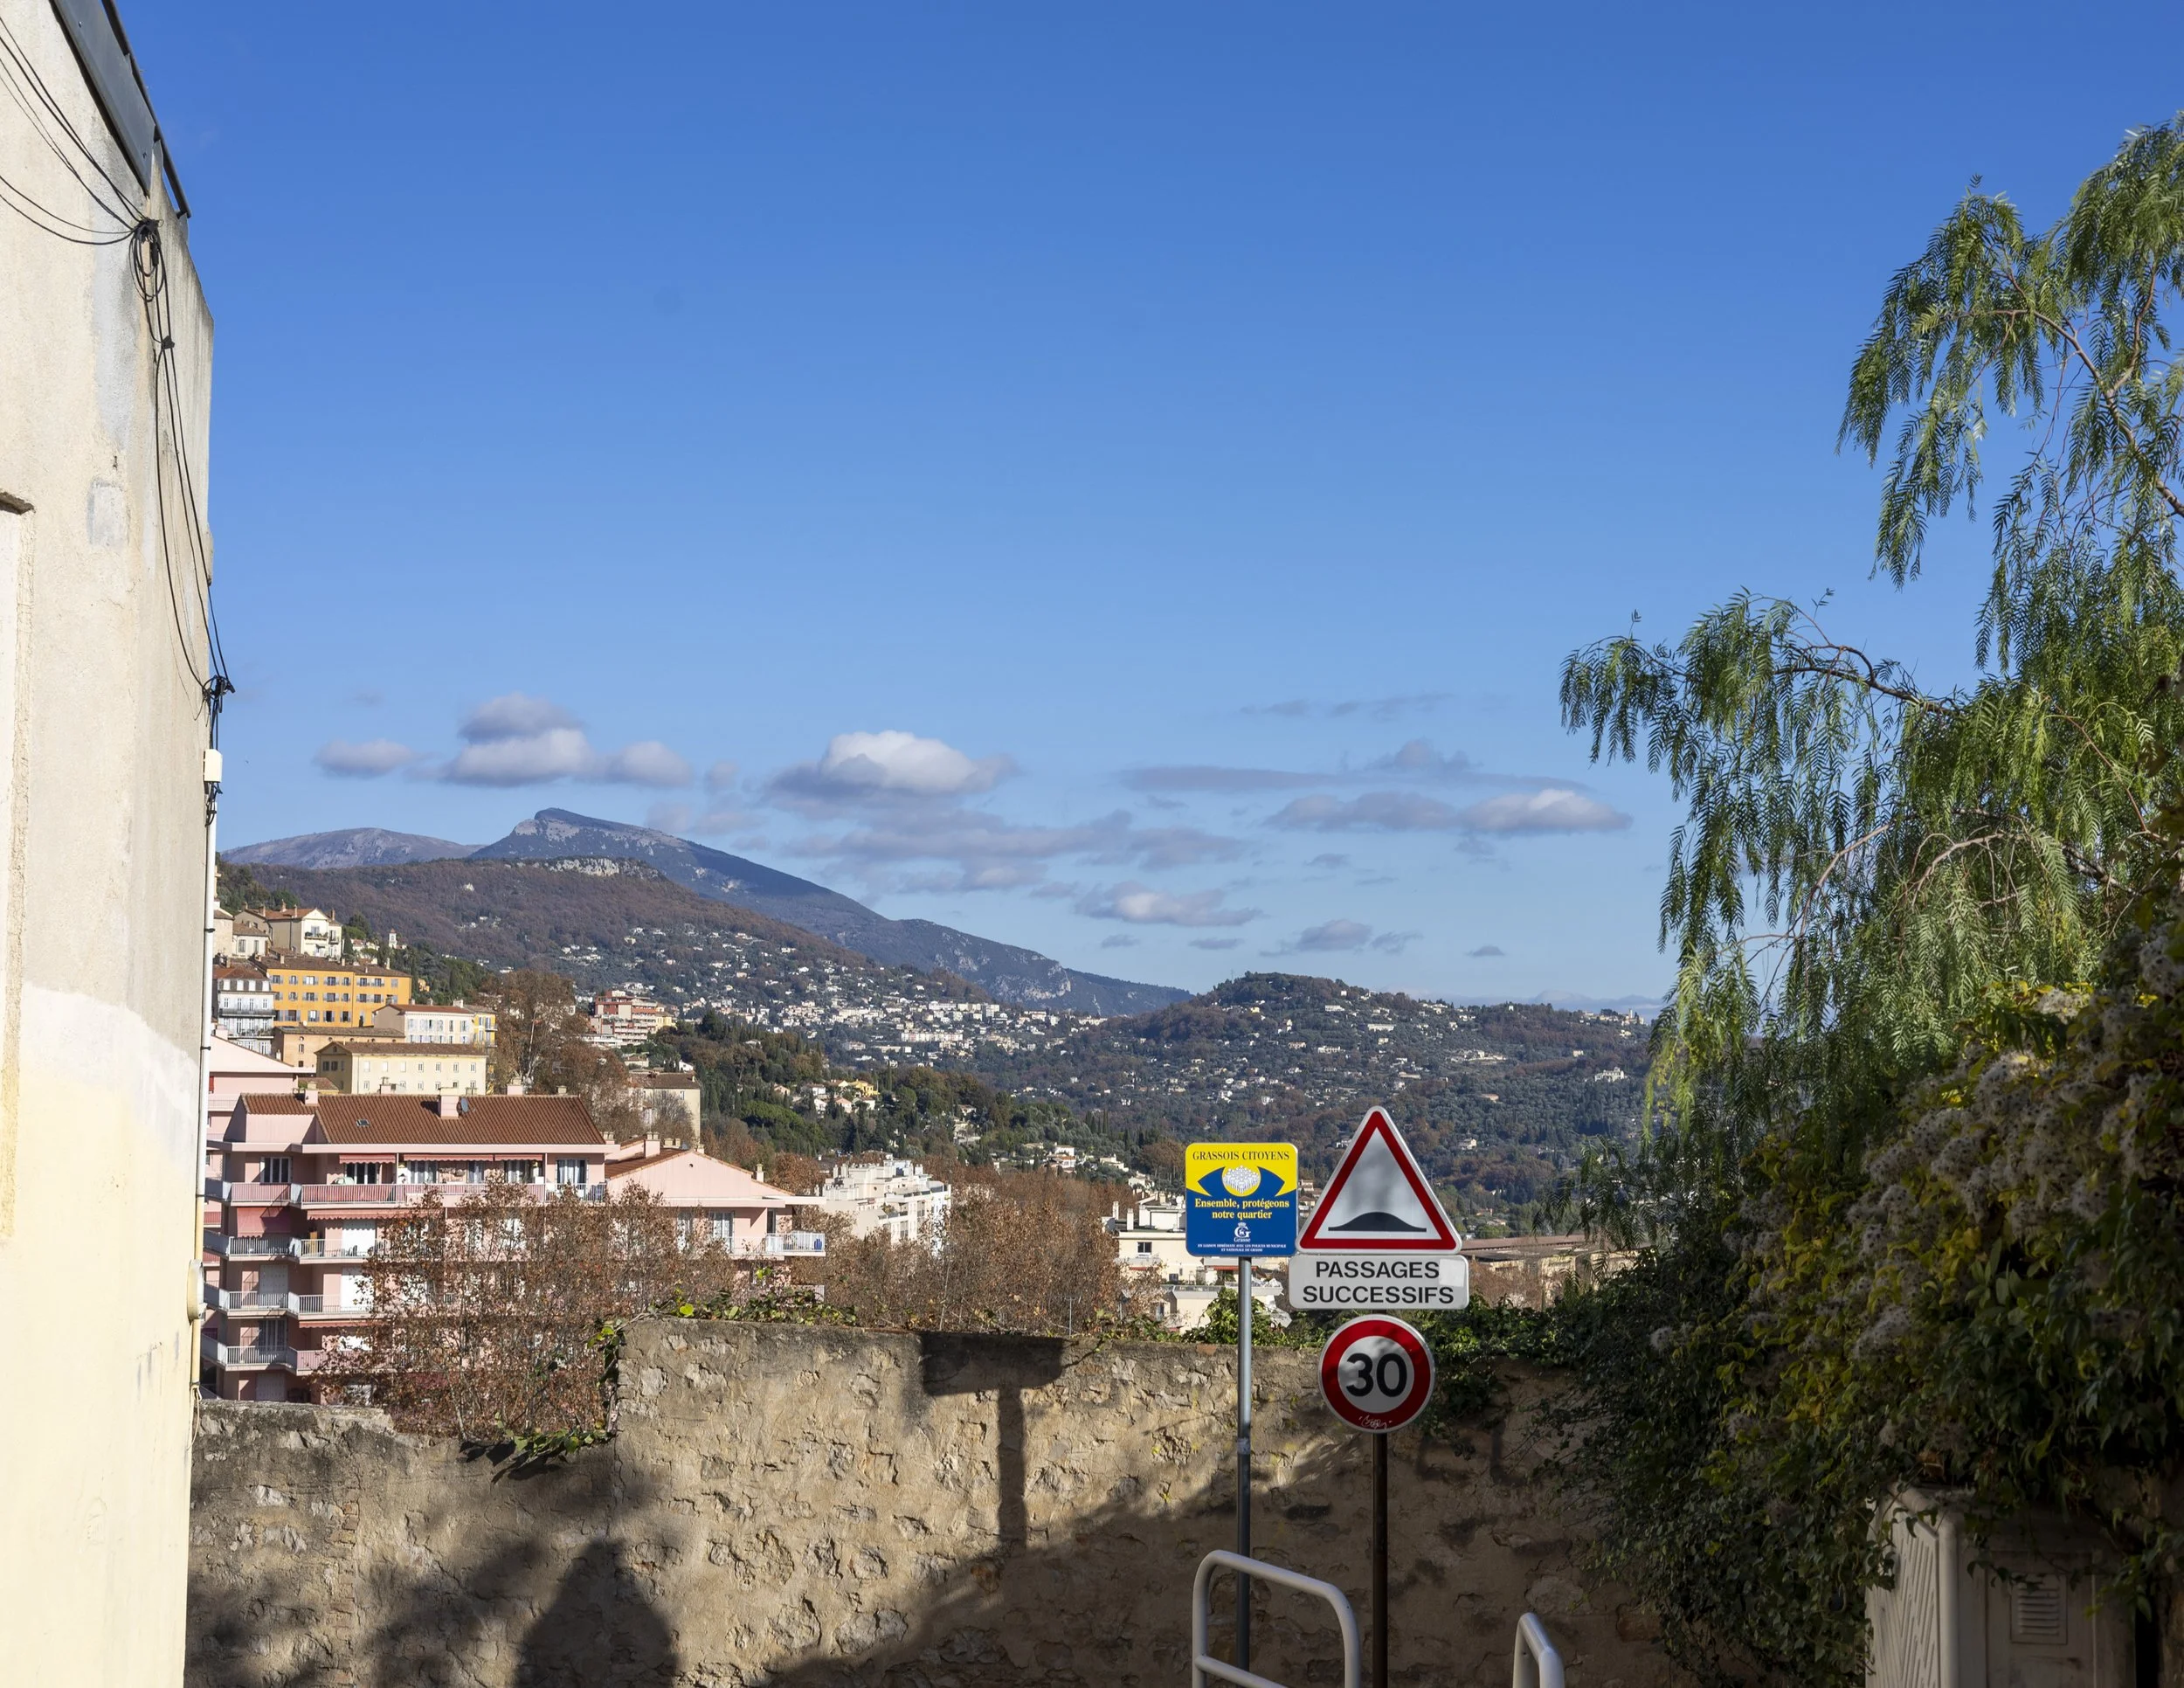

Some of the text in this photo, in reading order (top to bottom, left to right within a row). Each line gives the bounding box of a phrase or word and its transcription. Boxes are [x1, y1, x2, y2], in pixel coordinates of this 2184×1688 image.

[1192, 1151, 1290, 1160] GRASSOIS CITOYENS
[1195, 1198, 1289, 1209] Ensemble, protégeons
[1237, 1210, 1272, 1220] quartier
[1316, 1261, 1440, 1278] PASSAGES
[1303, 1286, 1454, 1304] SUCCESSIFS
[1345, 1352, 1407, 1397] 30
